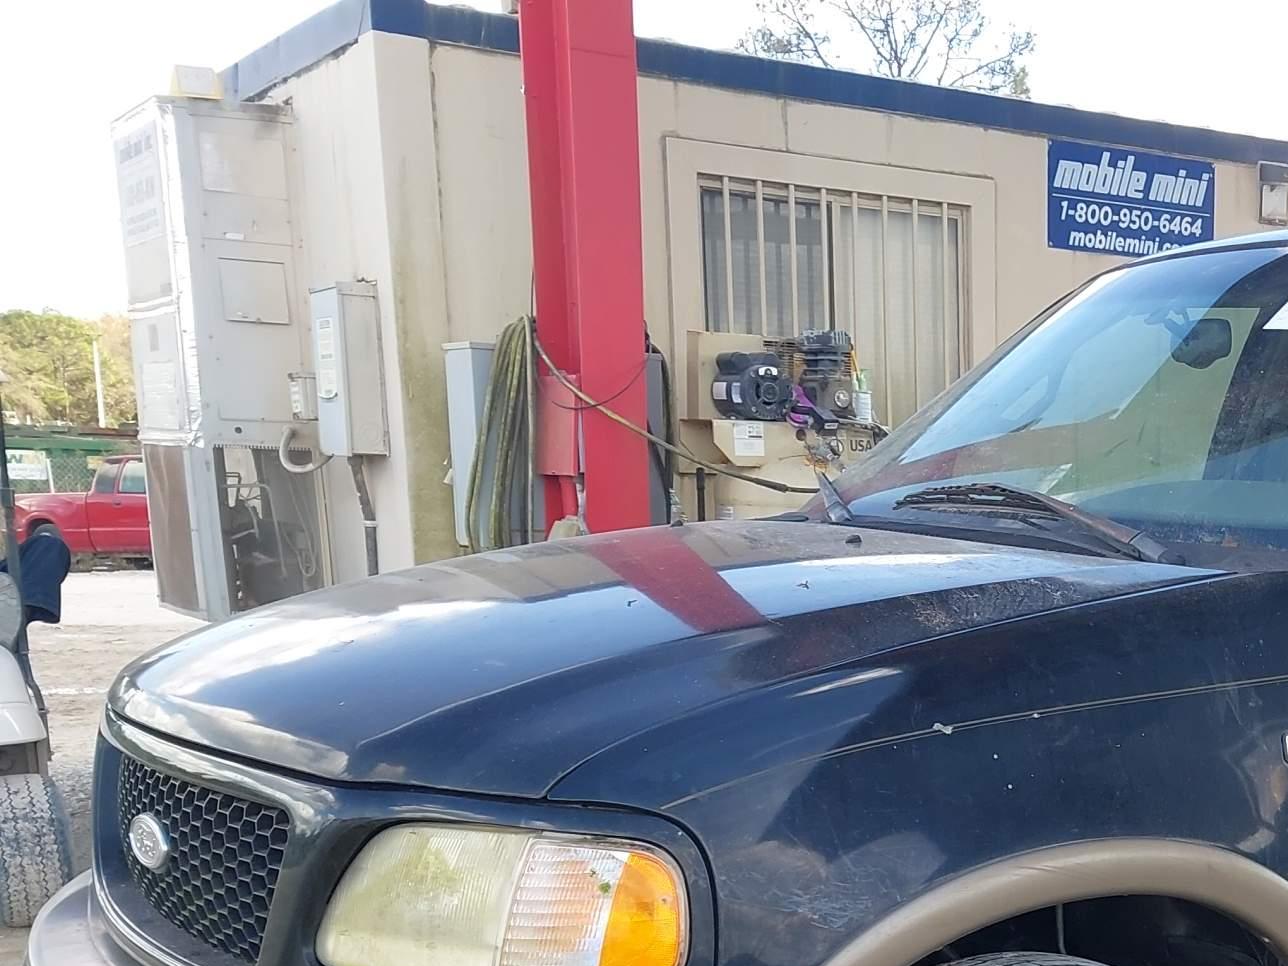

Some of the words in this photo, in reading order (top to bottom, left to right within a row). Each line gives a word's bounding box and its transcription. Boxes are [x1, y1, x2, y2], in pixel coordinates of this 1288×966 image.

[1053, 151, 1147, 199] mobile
[1148, 169, 1209, 207] mini
[1060, 201, 1202, 237] 1-800-950-6464
[1069, 230, 1186, 255] mobilemini.c
[850, 439, 872, 452] USA
